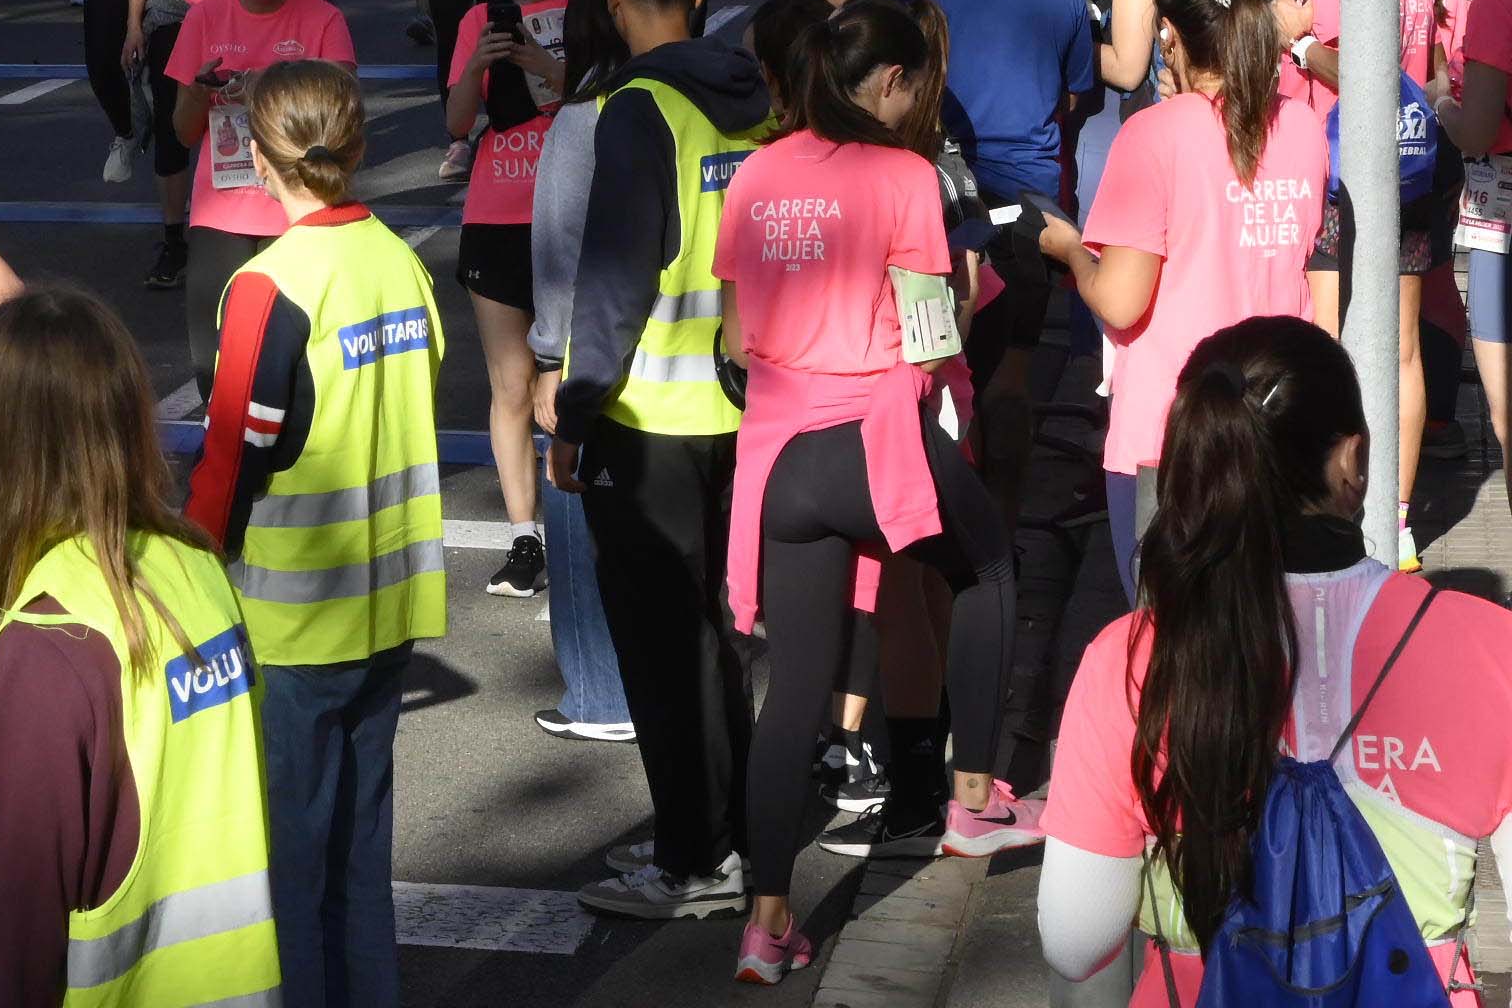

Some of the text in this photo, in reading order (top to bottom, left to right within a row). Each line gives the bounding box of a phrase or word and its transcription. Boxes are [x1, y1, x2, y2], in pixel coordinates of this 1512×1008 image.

[1226, 179, 1313, 205] CARRERA
[751, 197, 842, 223] CARRERA
[1243, 202, 1298, 225] DE LA
[764, 220, 822, 240] DE LA
[1239, 223, 1300, 248] MUJER
[761, 240, 825, 263] MUJER
